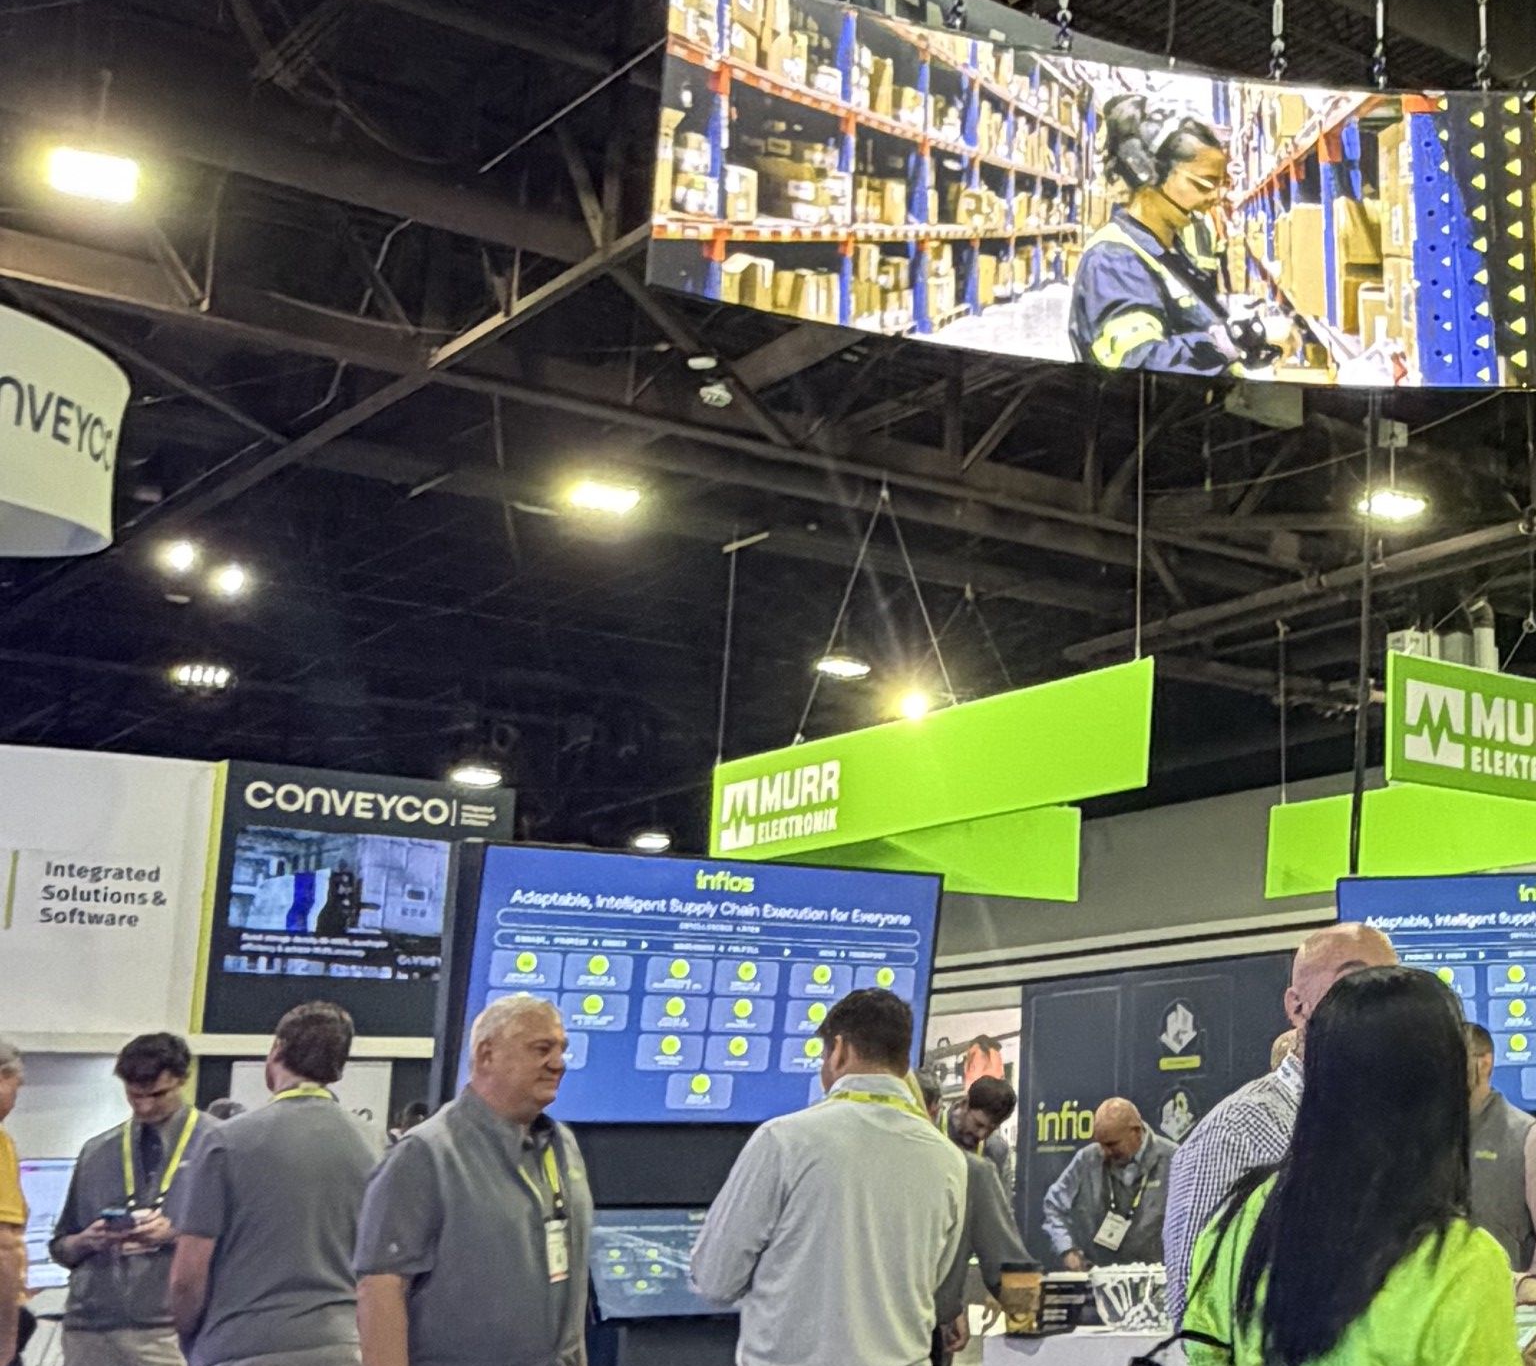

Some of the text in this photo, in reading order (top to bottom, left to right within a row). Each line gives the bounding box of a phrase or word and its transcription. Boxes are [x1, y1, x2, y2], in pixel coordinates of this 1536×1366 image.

[760, 759, 841, 815] MURR
[757, 807, 838, 845] ELEKTRONIK
[45, 861, 161, 883] Integrated
[695, 869, 755, 893] infios
[41, 885, 167, 906] Solutions &
[39, 907, 140, 927] Software
[595, 893, 667, 914] Intelligent
[669, 899, 719, 918] Supply
[720, 901, 761, 918] Chain
[762, 903, 829, 922] Execution
[830, 907, 850, 923] for
[851, 908, 912, 927] Everyone
[1434, 913, 1496, 928] Intelligent
[1037, 1100, 1095, 1141] infio
